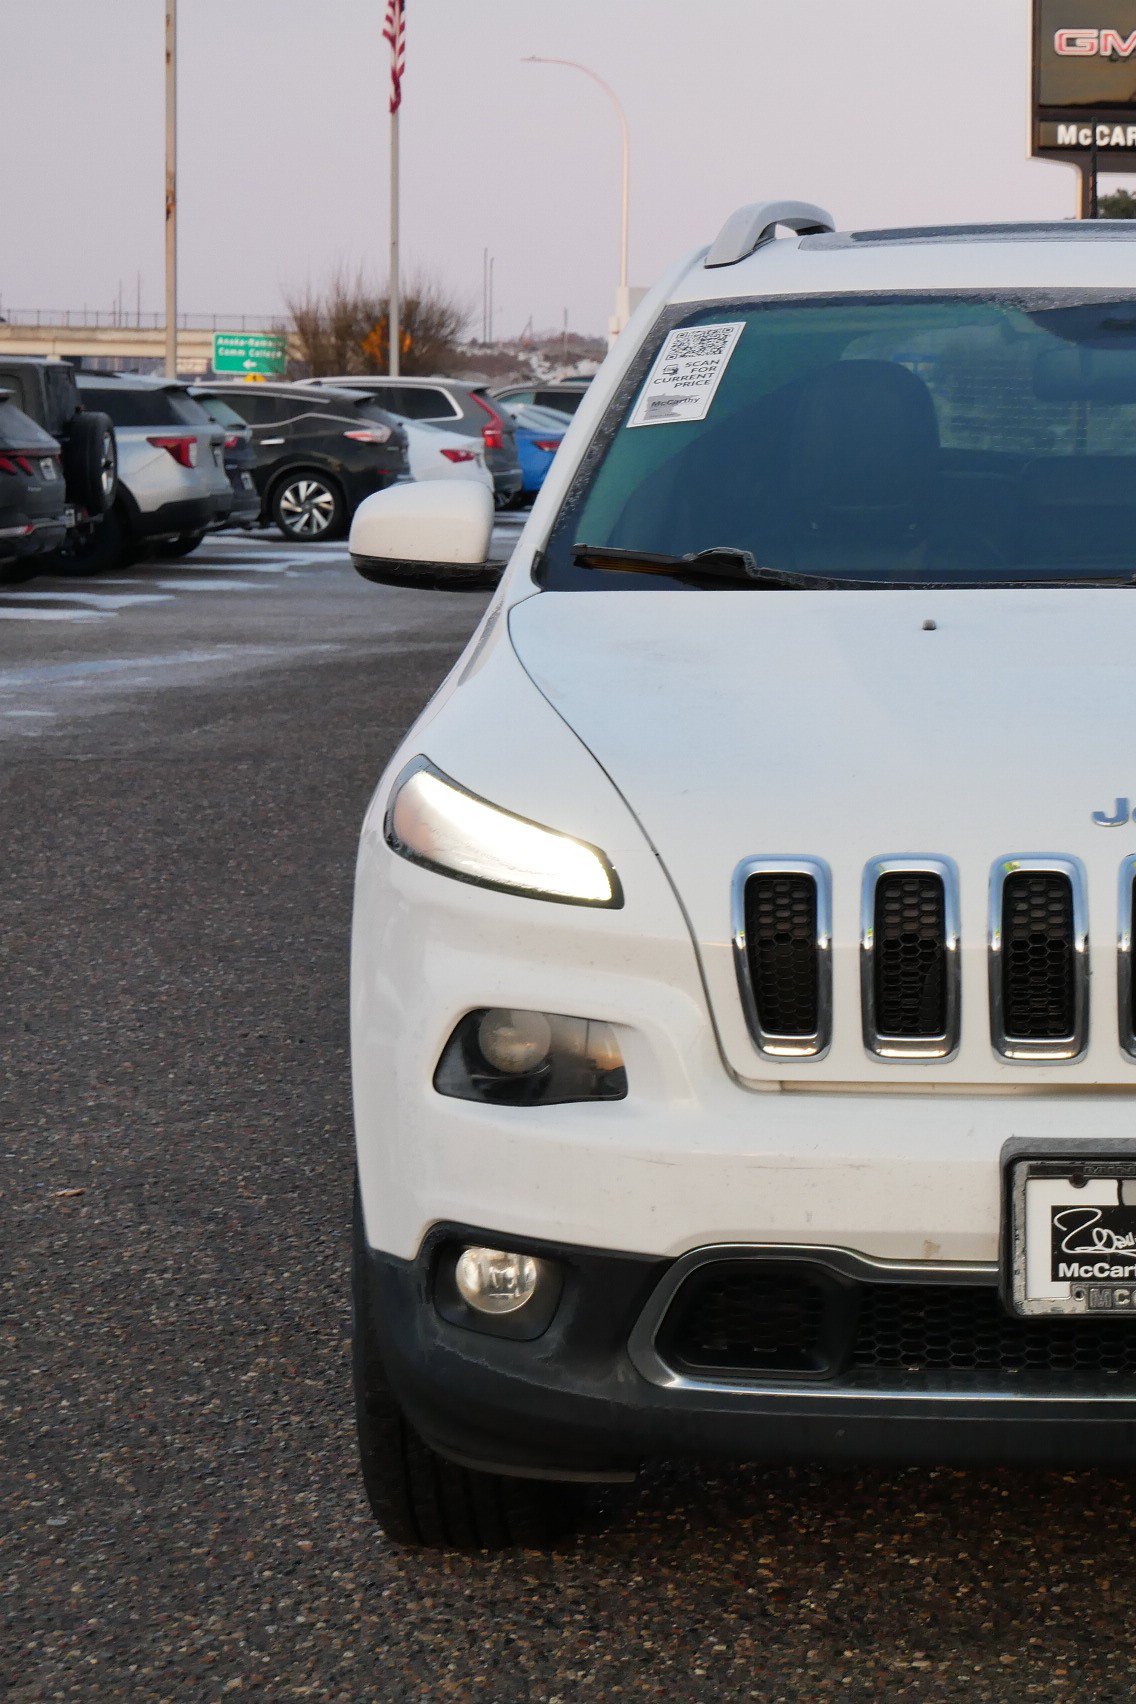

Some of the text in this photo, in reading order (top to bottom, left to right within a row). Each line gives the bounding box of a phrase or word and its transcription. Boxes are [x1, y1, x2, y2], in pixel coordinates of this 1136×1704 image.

[685, 359, 720, 369] SCAN
[690, 365, 717, 374] FOR
[653, 372, 715, 385] CURRENT
[674, 379, 711, 389] PRICE
[650, 397, 701, 408] McCarthy
